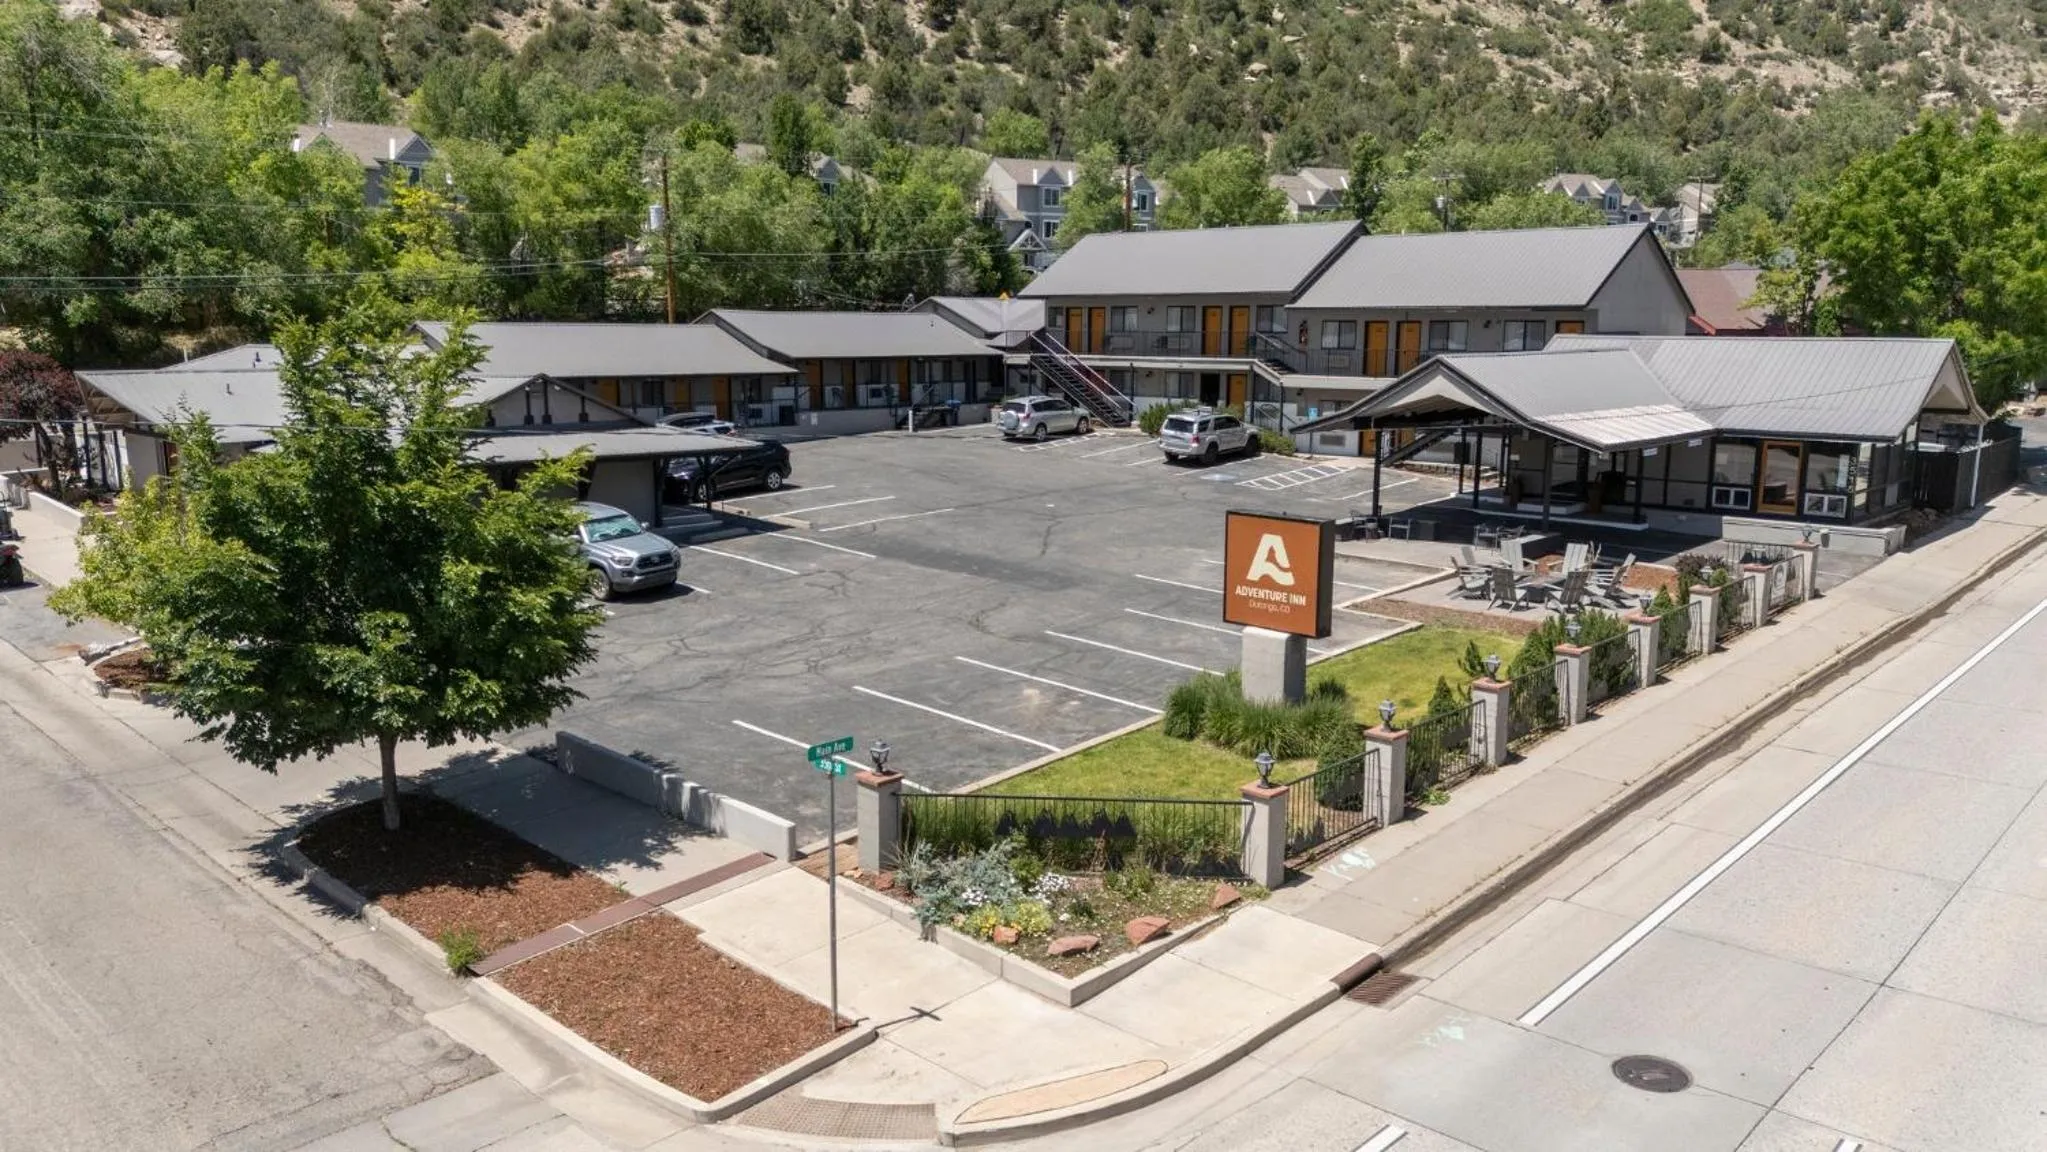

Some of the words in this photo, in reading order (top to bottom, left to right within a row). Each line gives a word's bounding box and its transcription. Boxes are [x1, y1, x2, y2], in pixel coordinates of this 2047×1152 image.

[1246, 533, 1295, 586] A
[1235, 584, 1288, 603] ADVENTURE
[1289, 592, 1306, 606] INN
